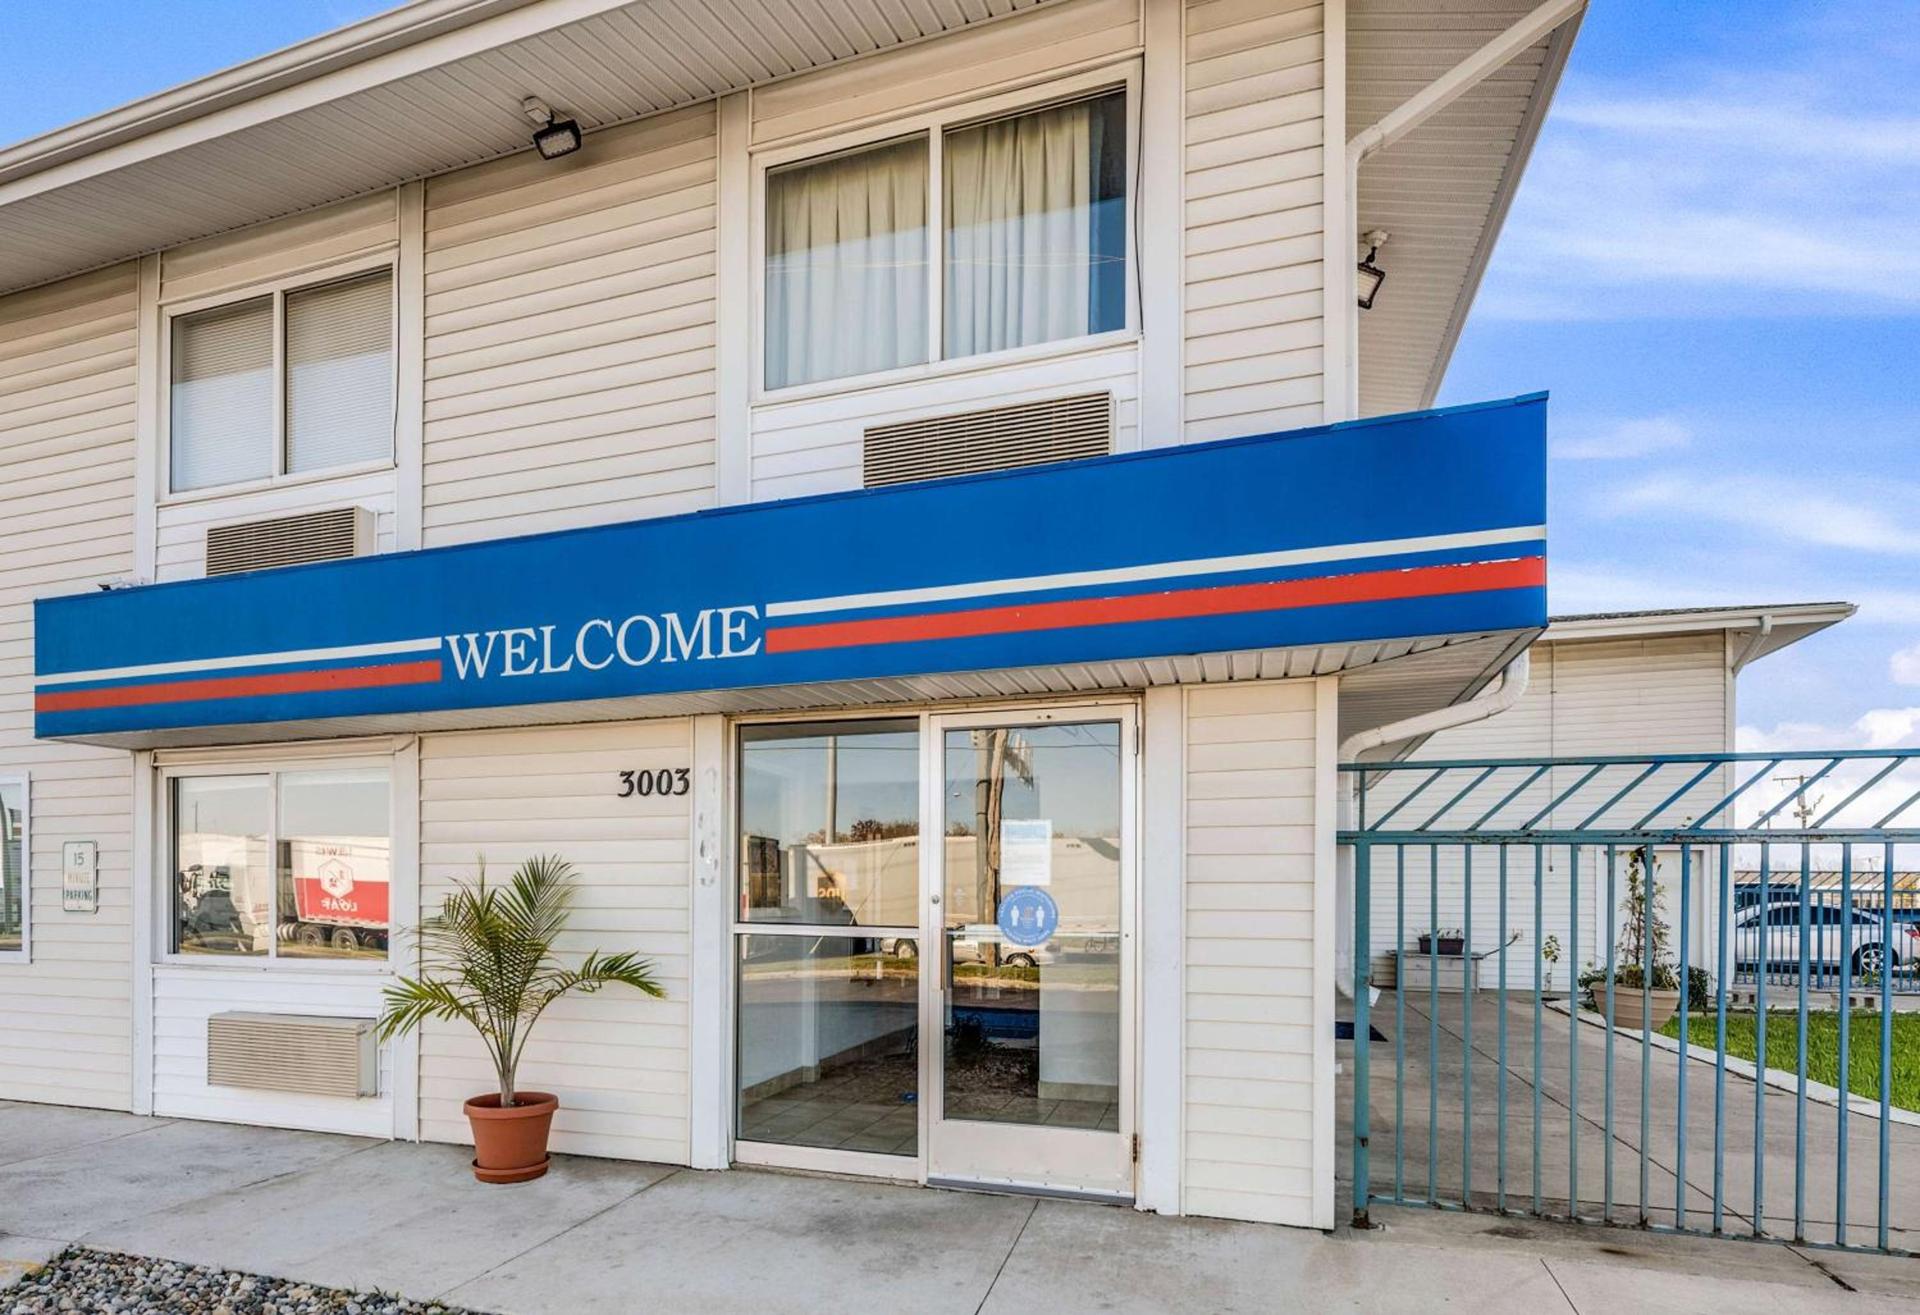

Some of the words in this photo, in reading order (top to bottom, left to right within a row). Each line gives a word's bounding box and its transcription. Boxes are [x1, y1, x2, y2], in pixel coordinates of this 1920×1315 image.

[445, 605, 761, 681] WELCOME
[617, 767, 690, 798] 3003
[74, 852, 85, 866] 15
[65, 889, 93, 901] PARKING
